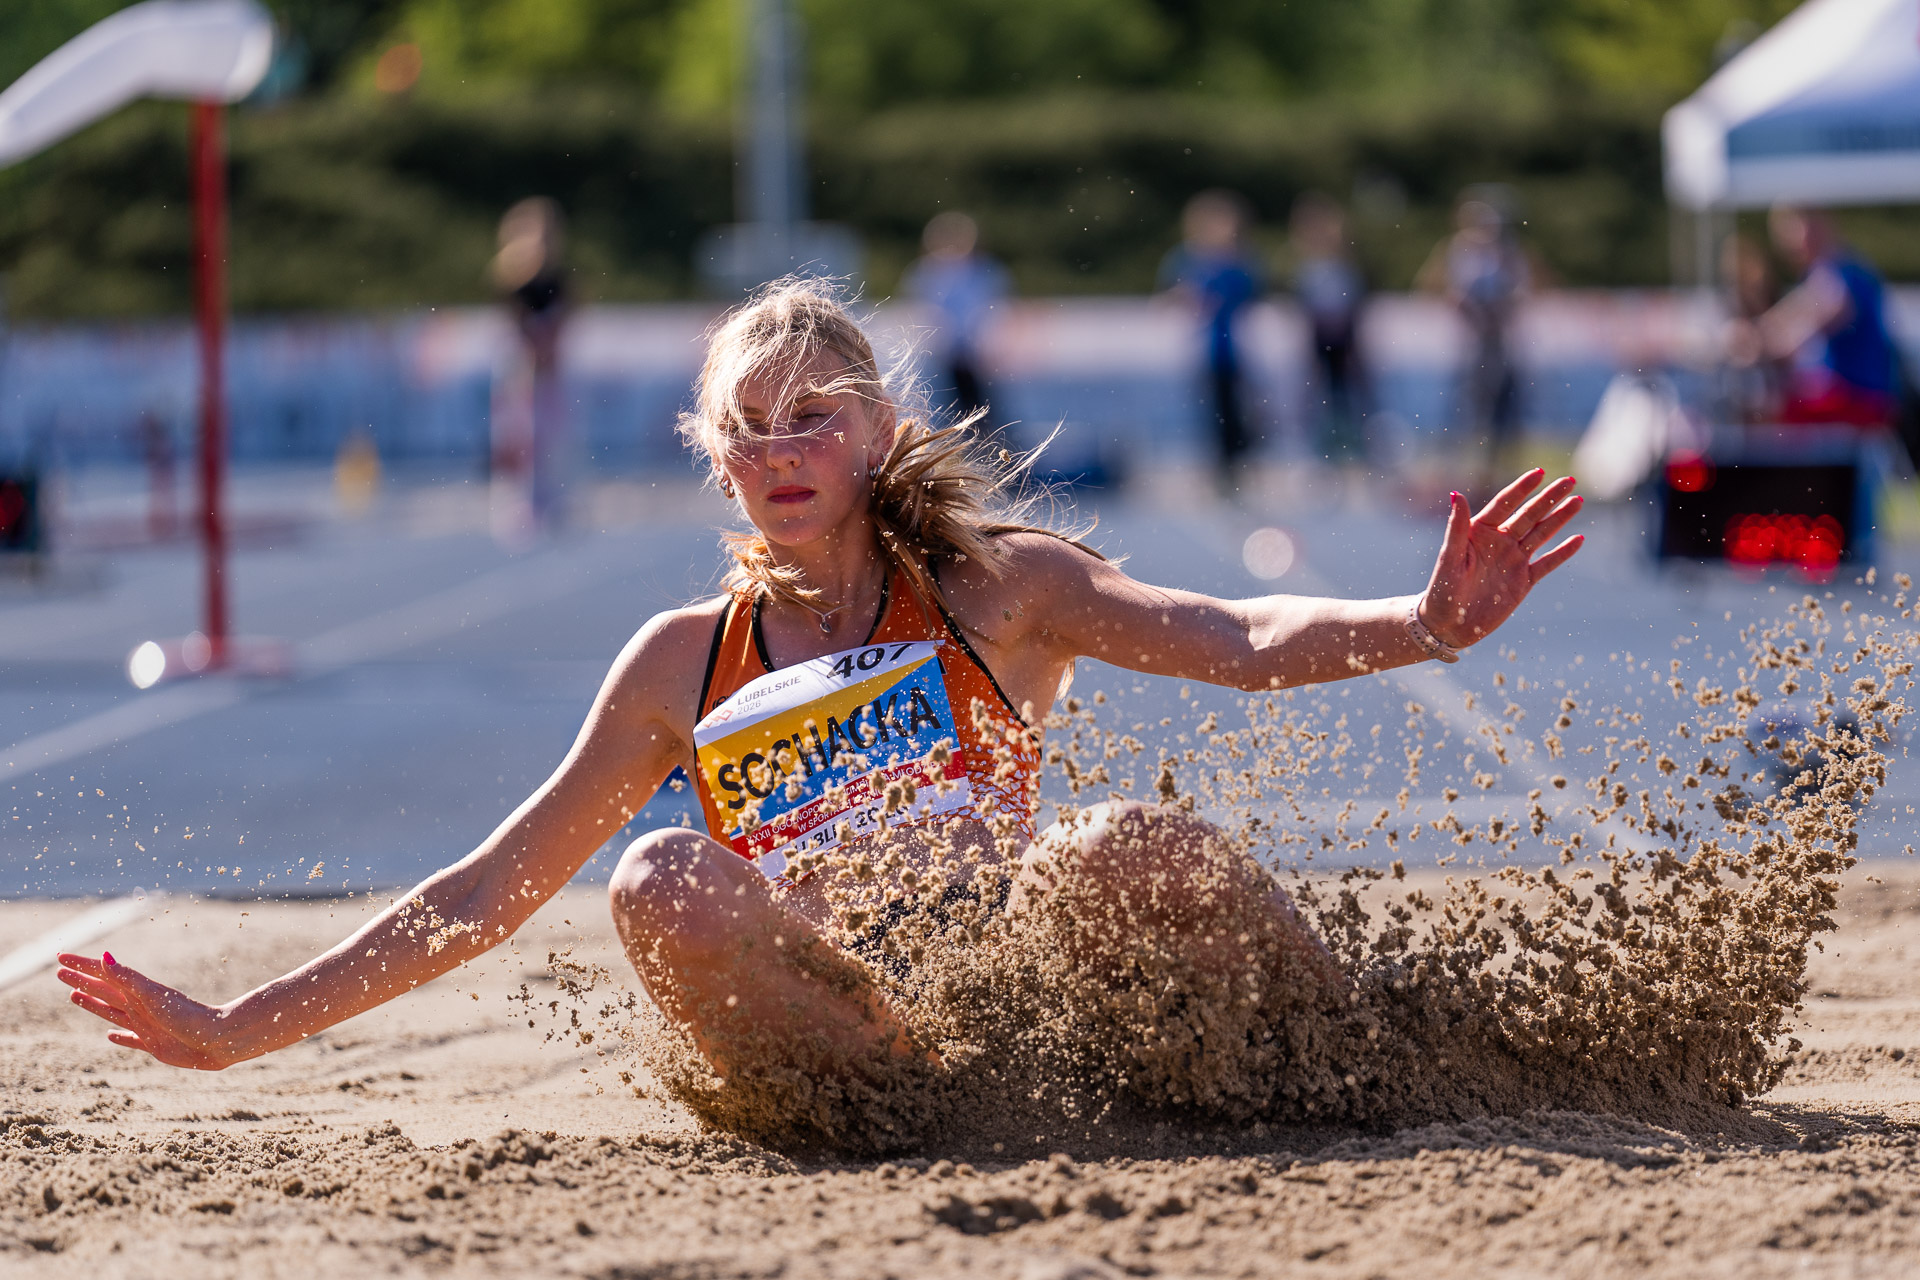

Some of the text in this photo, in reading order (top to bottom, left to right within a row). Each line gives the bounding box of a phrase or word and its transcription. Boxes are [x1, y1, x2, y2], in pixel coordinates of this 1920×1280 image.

[827, 643, 914, 679] 407
[737, 675, 801, 705] LUBELSKIE
[737, 700, 761, 715] 2026
[718, 686, 941, 810] SOCHACKA
[798, 822, 807, 833] W
